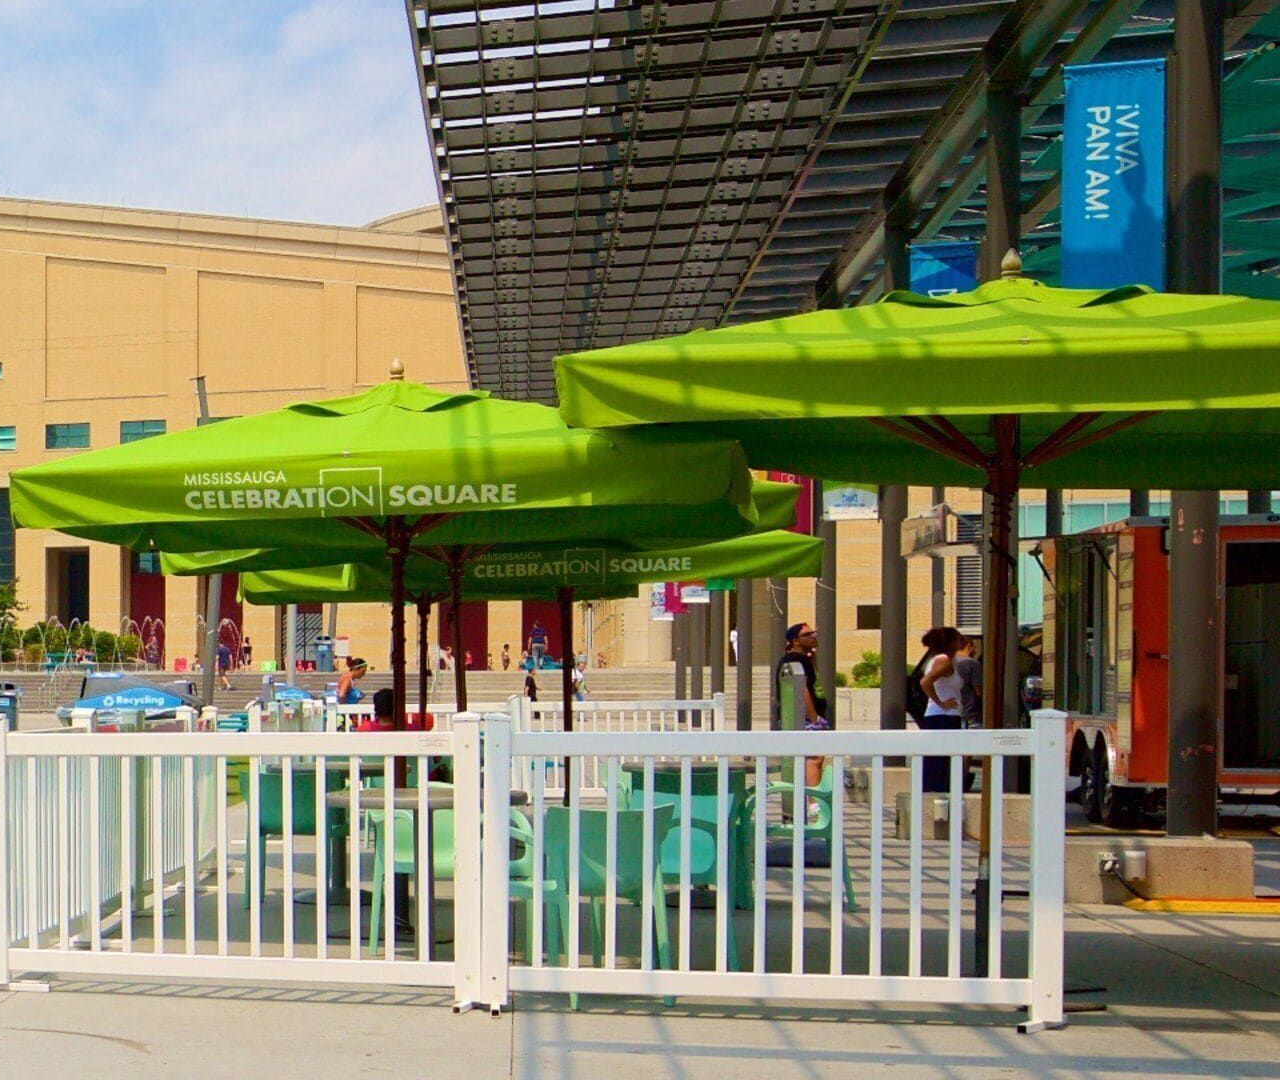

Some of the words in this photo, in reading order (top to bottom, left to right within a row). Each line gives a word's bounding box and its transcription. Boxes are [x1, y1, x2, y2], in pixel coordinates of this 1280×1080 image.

[1085, 106, 1111, 161] PAN
[1115, 104, 1140, 175] ¡VIVA
[1085, 170, 1110, 219] AM!
[183, 470, 287, 486] MISSISSAUGA
[184, 485, 374, 510] CELEBRATION
[389, 483, 517, 507] SQUARE
[473, 559, 601, 578] CELEBRATION
[608, 556, 691, 573] SQUARE
[116, 695, 165, 706] Recycling
